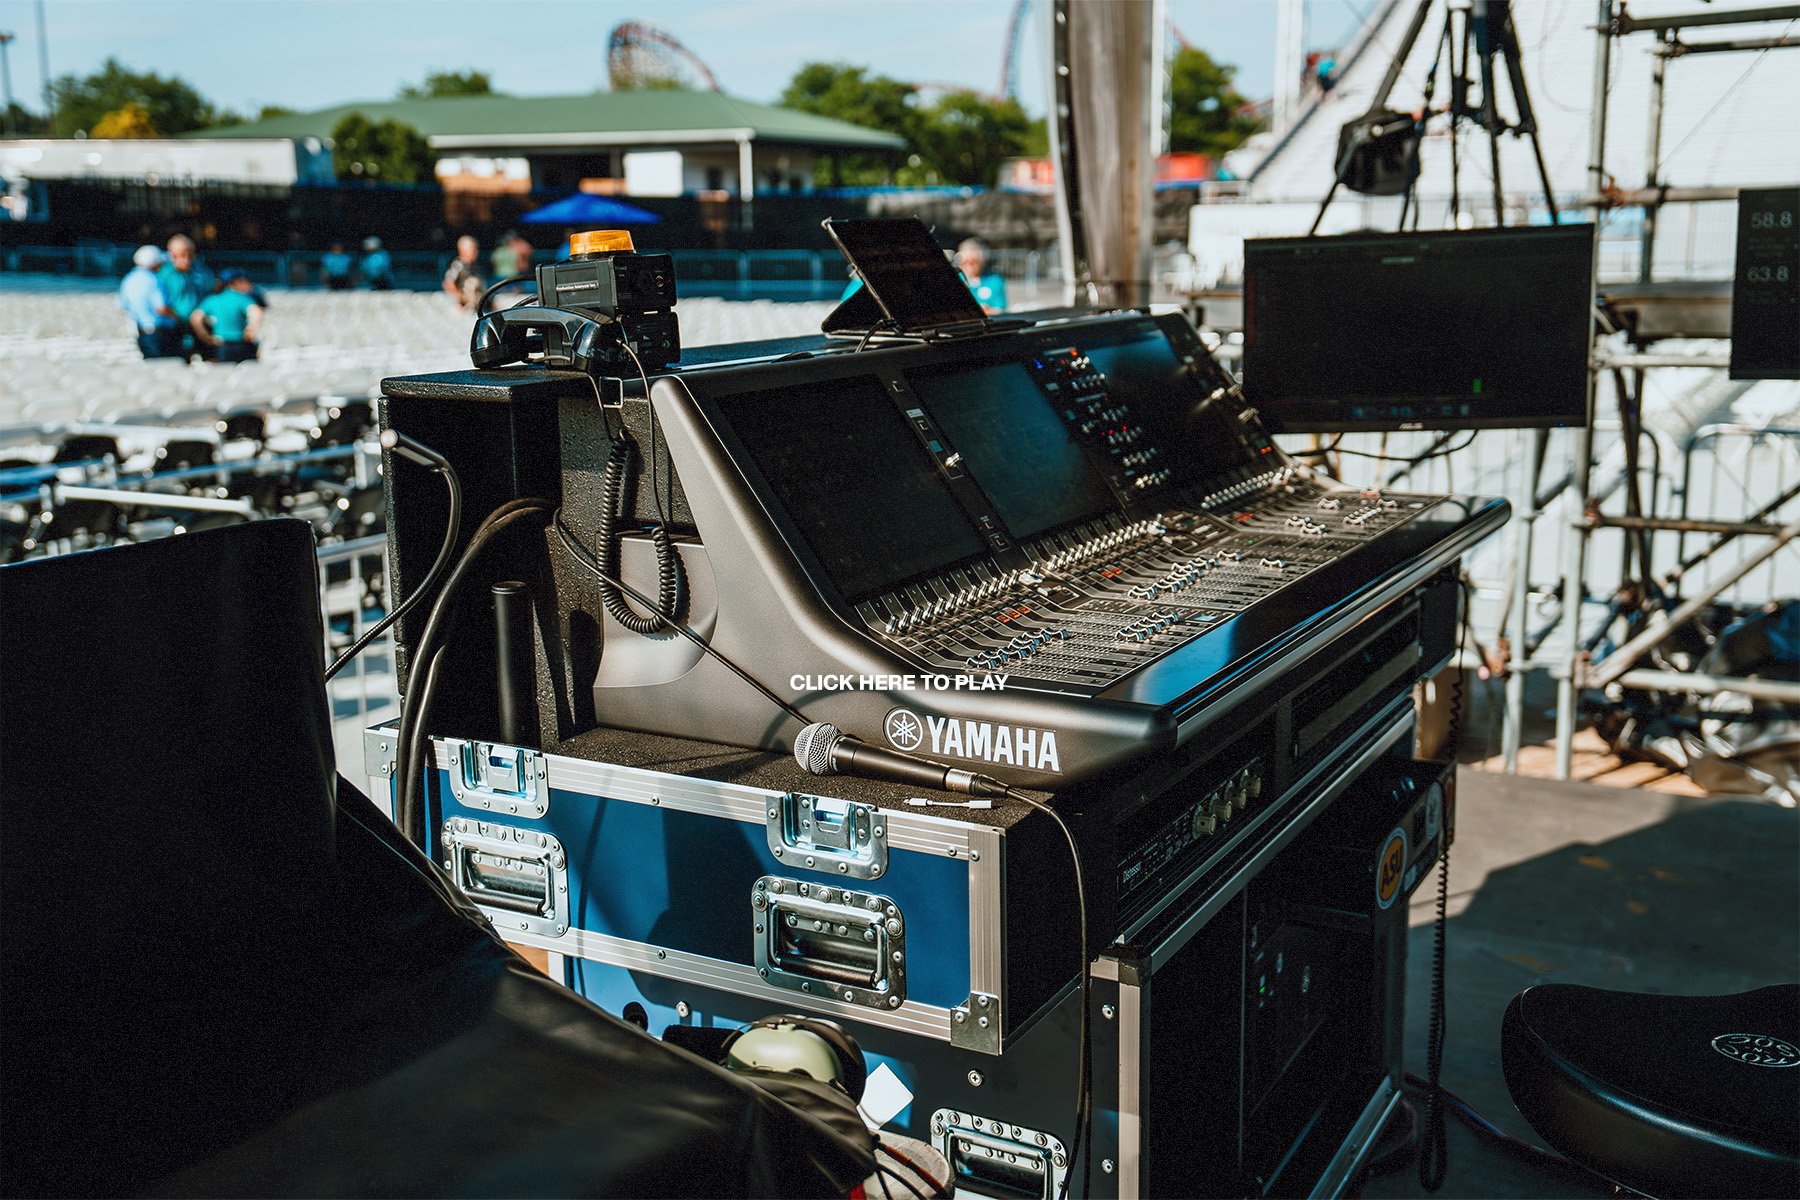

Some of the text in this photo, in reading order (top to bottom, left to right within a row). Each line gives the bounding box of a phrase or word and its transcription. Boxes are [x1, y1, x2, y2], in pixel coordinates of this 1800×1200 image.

[1751, 211, 1793, 229] 58.8
[1748, 265, 1789, 282] 63.8
[926, 715, 1060, 772] YAMAHA
